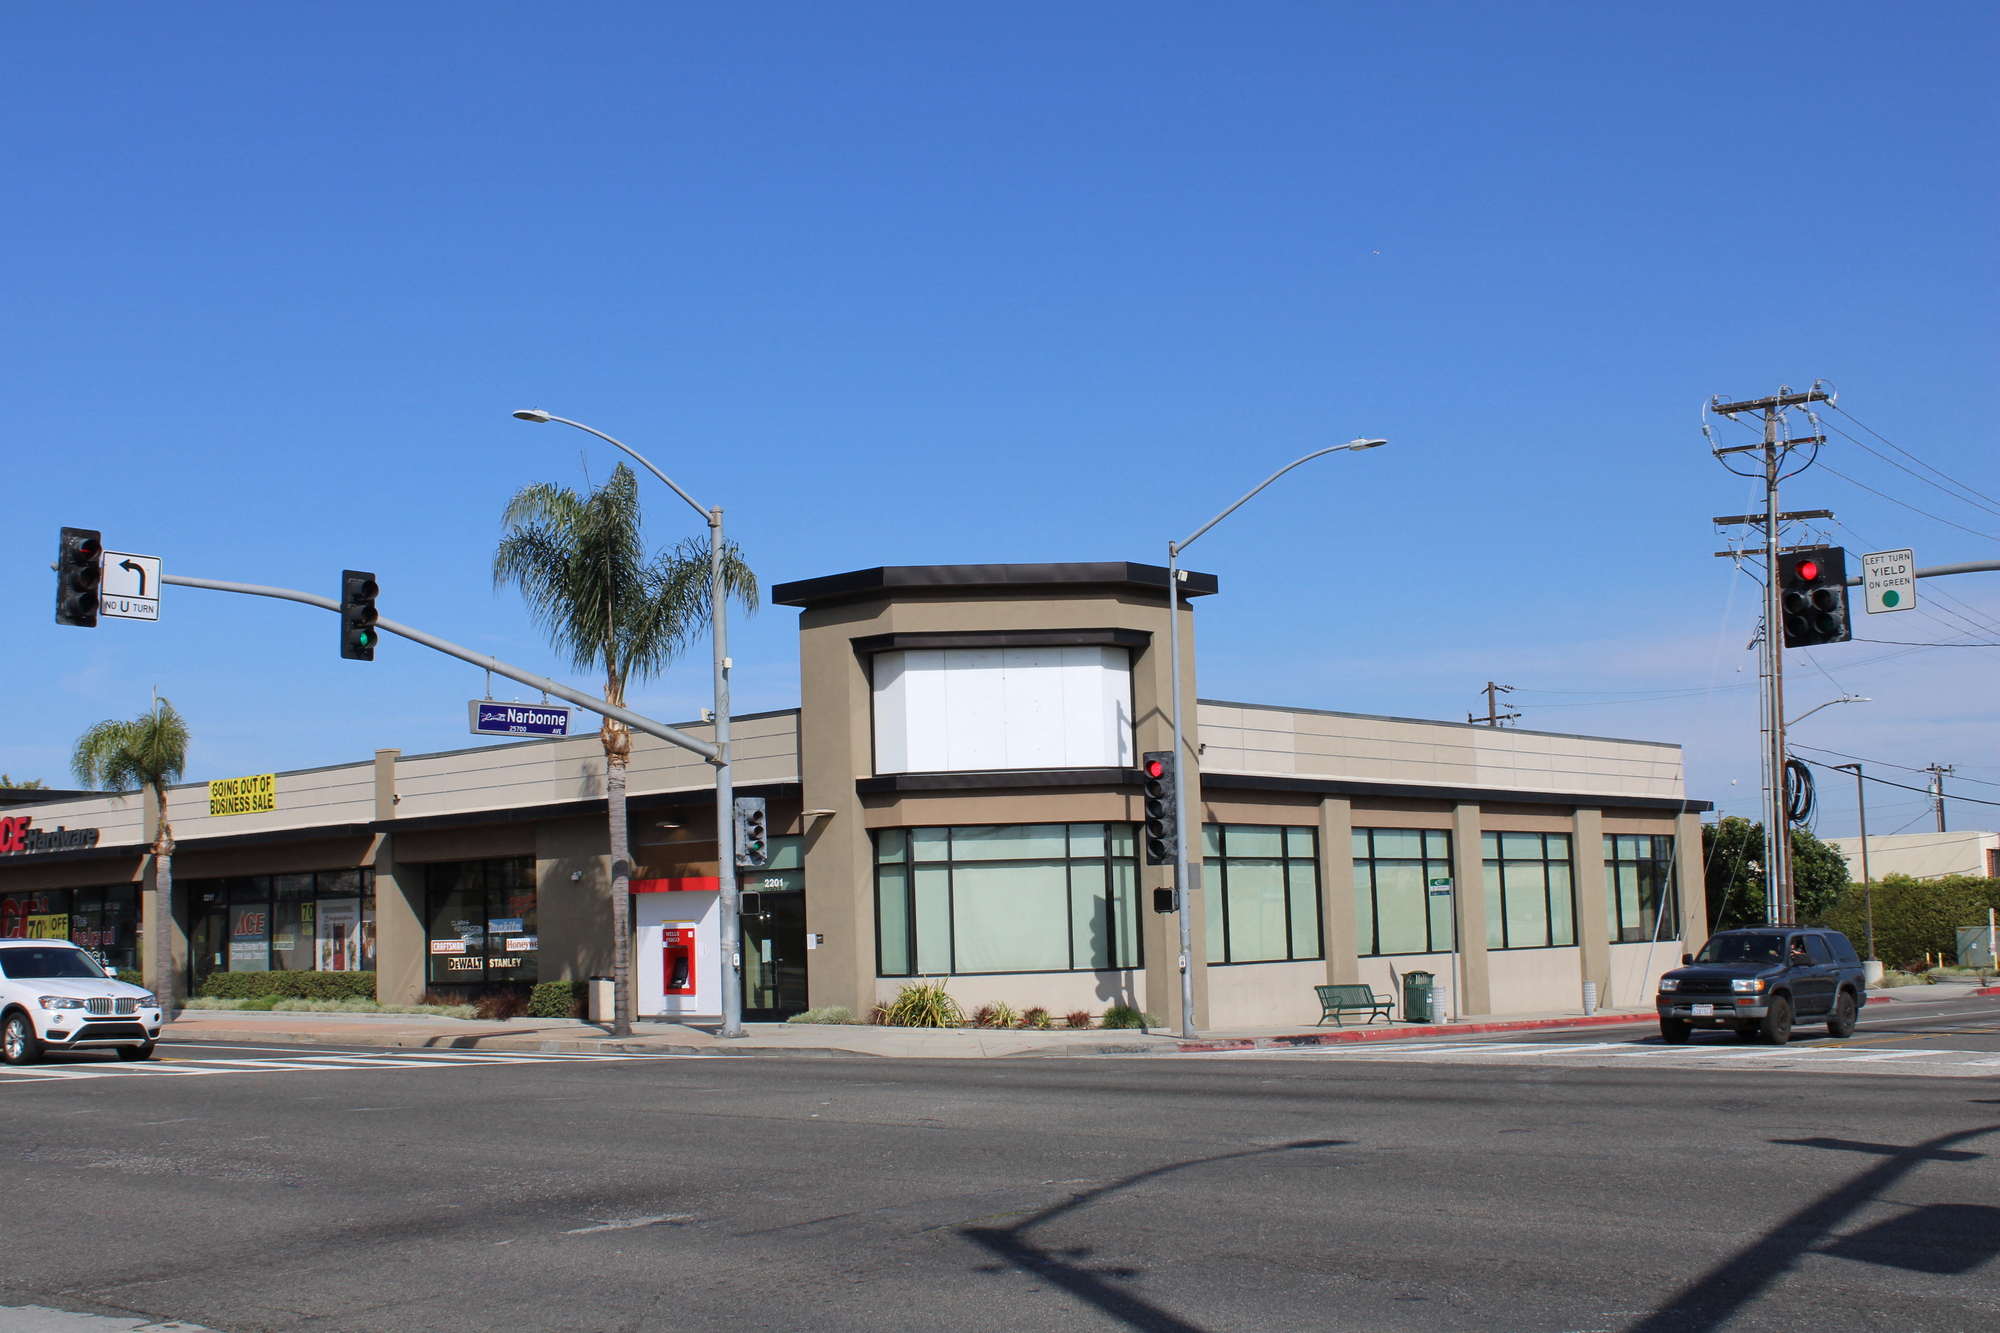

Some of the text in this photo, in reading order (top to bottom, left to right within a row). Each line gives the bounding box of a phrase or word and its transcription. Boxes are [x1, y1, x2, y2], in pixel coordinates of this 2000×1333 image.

[1865, 553, 1910, 565] LEFT TURN
[1871, 565, 1906, 577] YIELD
[1869, 577, 1910, 589] ON GREEN
[104, 600, 154, 613] NO U TURN
[507, 708, 566, 726] Narbonne
[212, 776, 271, 797] GOING OUT OF
[210, 793, 274, 815] BUSINESS SALE
[27, 826, 98, 849] Hardware
[764, 878, 784, 888] 2201
[51, 917, 67, 931] OFF
[72, 914, 88, 927] The
[234, 910, 266, 936] ACE
[72, 926, 115, 950] helpul
[433, 942, 465, 951] CRAFTSMAN
[489, 958, 521, 968] STANLEY
